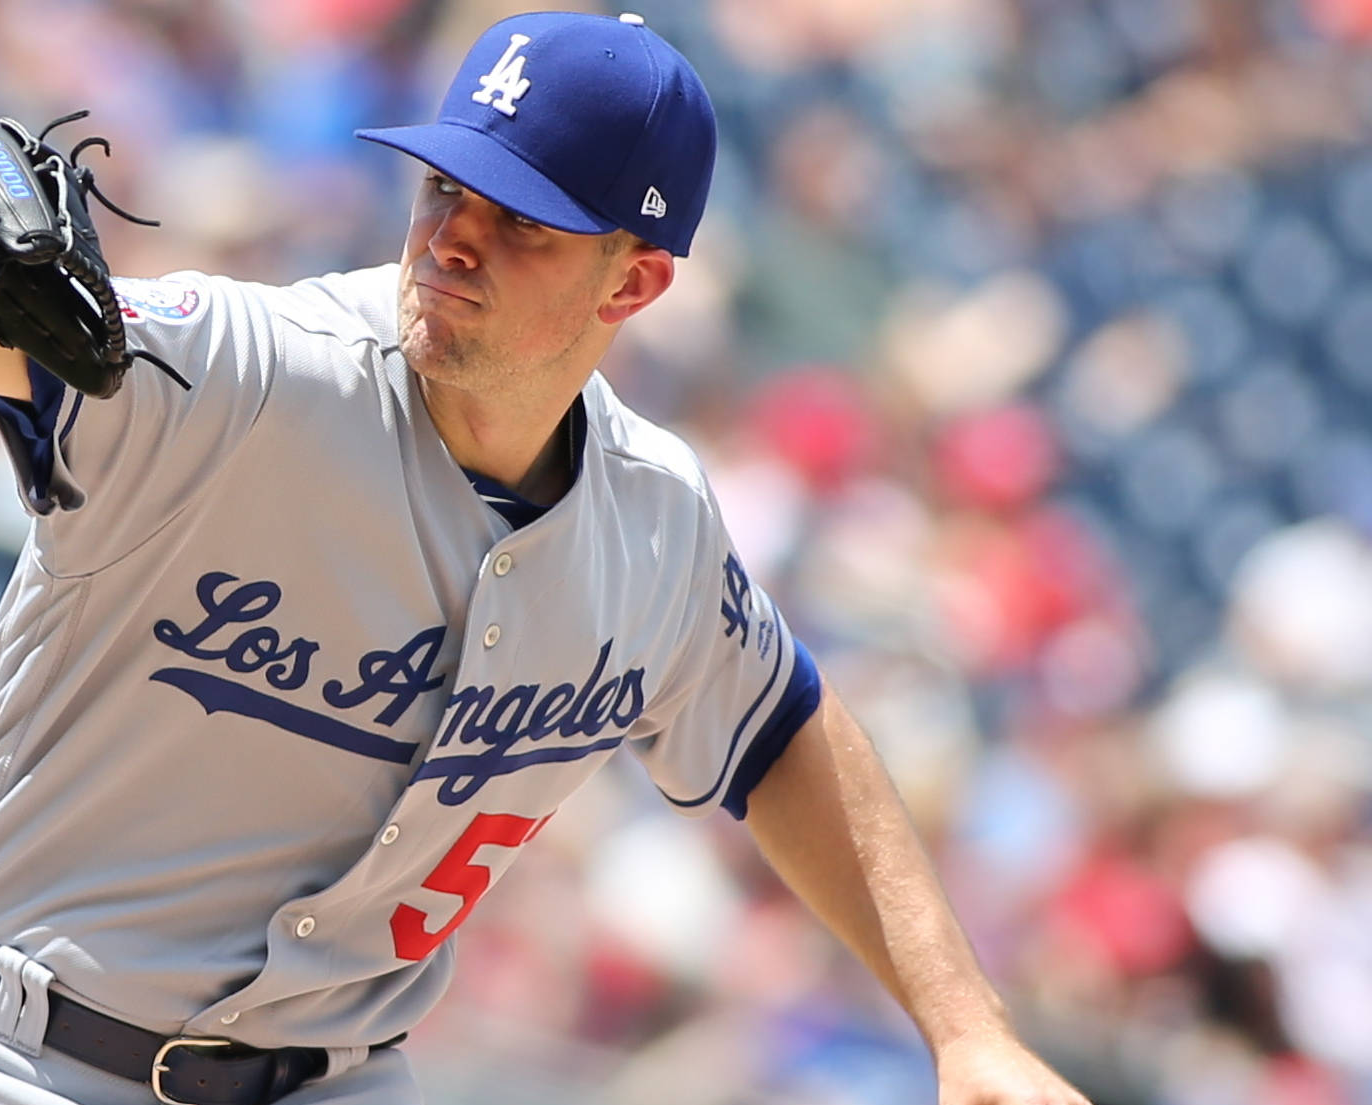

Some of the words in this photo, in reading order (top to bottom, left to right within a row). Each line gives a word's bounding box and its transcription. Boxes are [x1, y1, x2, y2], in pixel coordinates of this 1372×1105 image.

[472, 33, 531, 117] LA
[153, 571, 320, 690] Los
[322, 625, 646, 807] Angeles
[389, 809, 558, 962] 5
